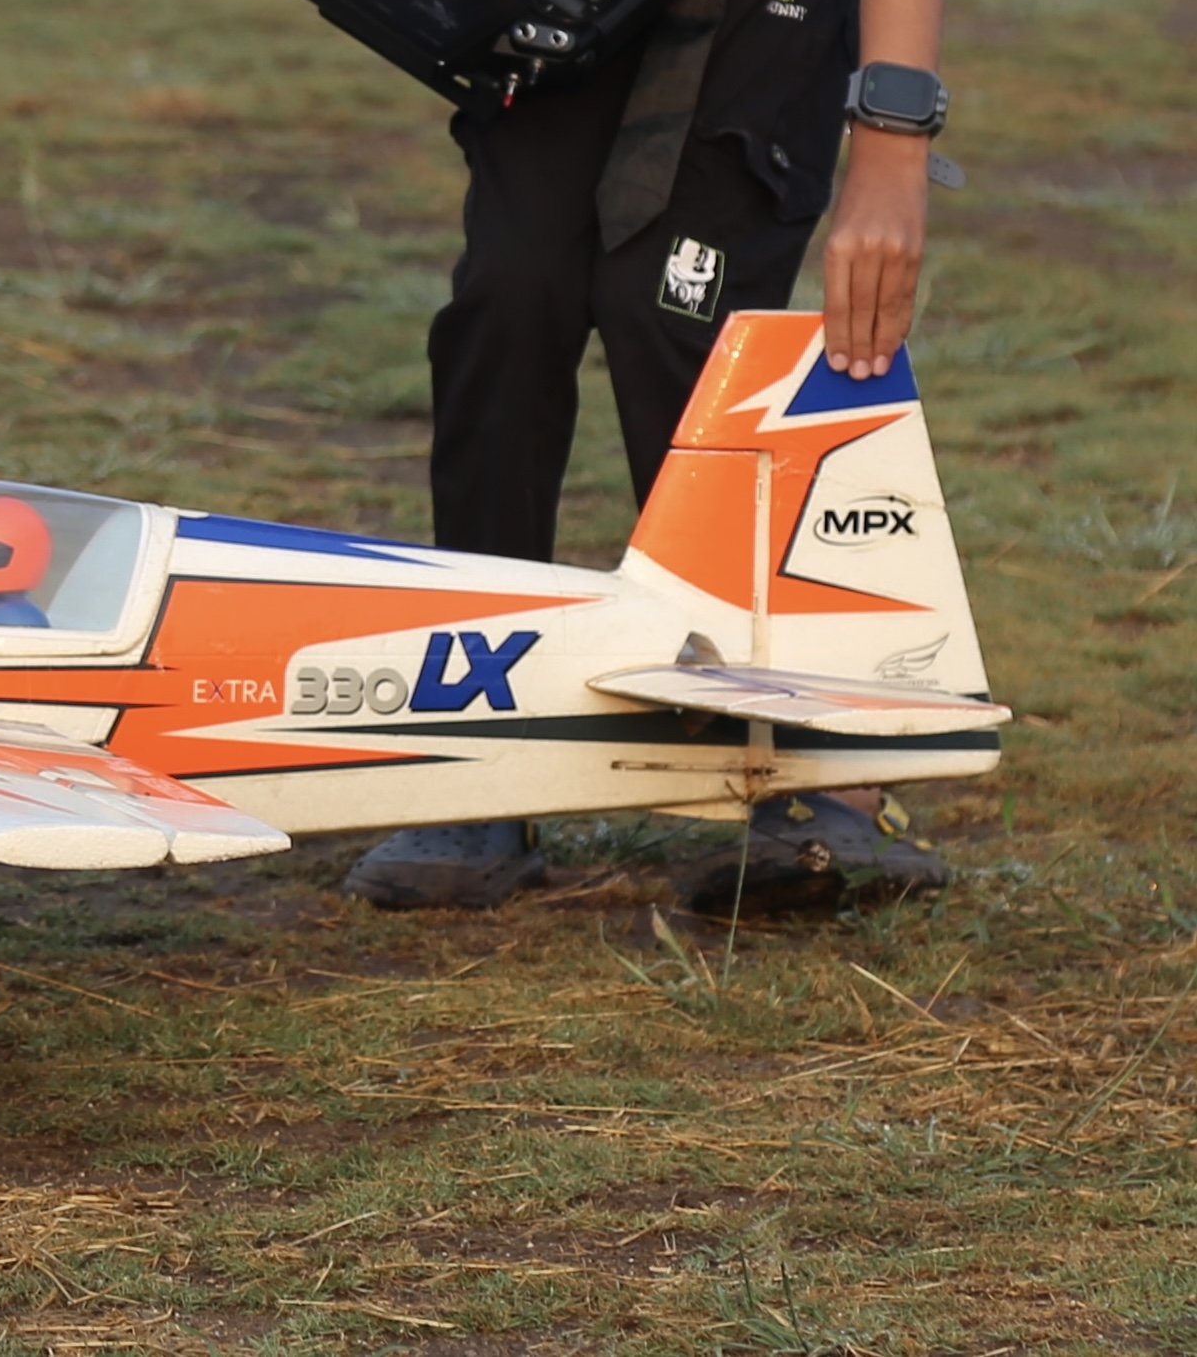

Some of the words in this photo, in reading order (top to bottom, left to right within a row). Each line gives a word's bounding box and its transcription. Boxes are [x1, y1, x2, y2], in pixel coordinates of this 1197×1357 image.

[824, 509, 916, 535] MPX
[192, 679, 278, 704] EXTRA
[290, 667, 409, 715] 330
[408, 631, 544, 713] LX
